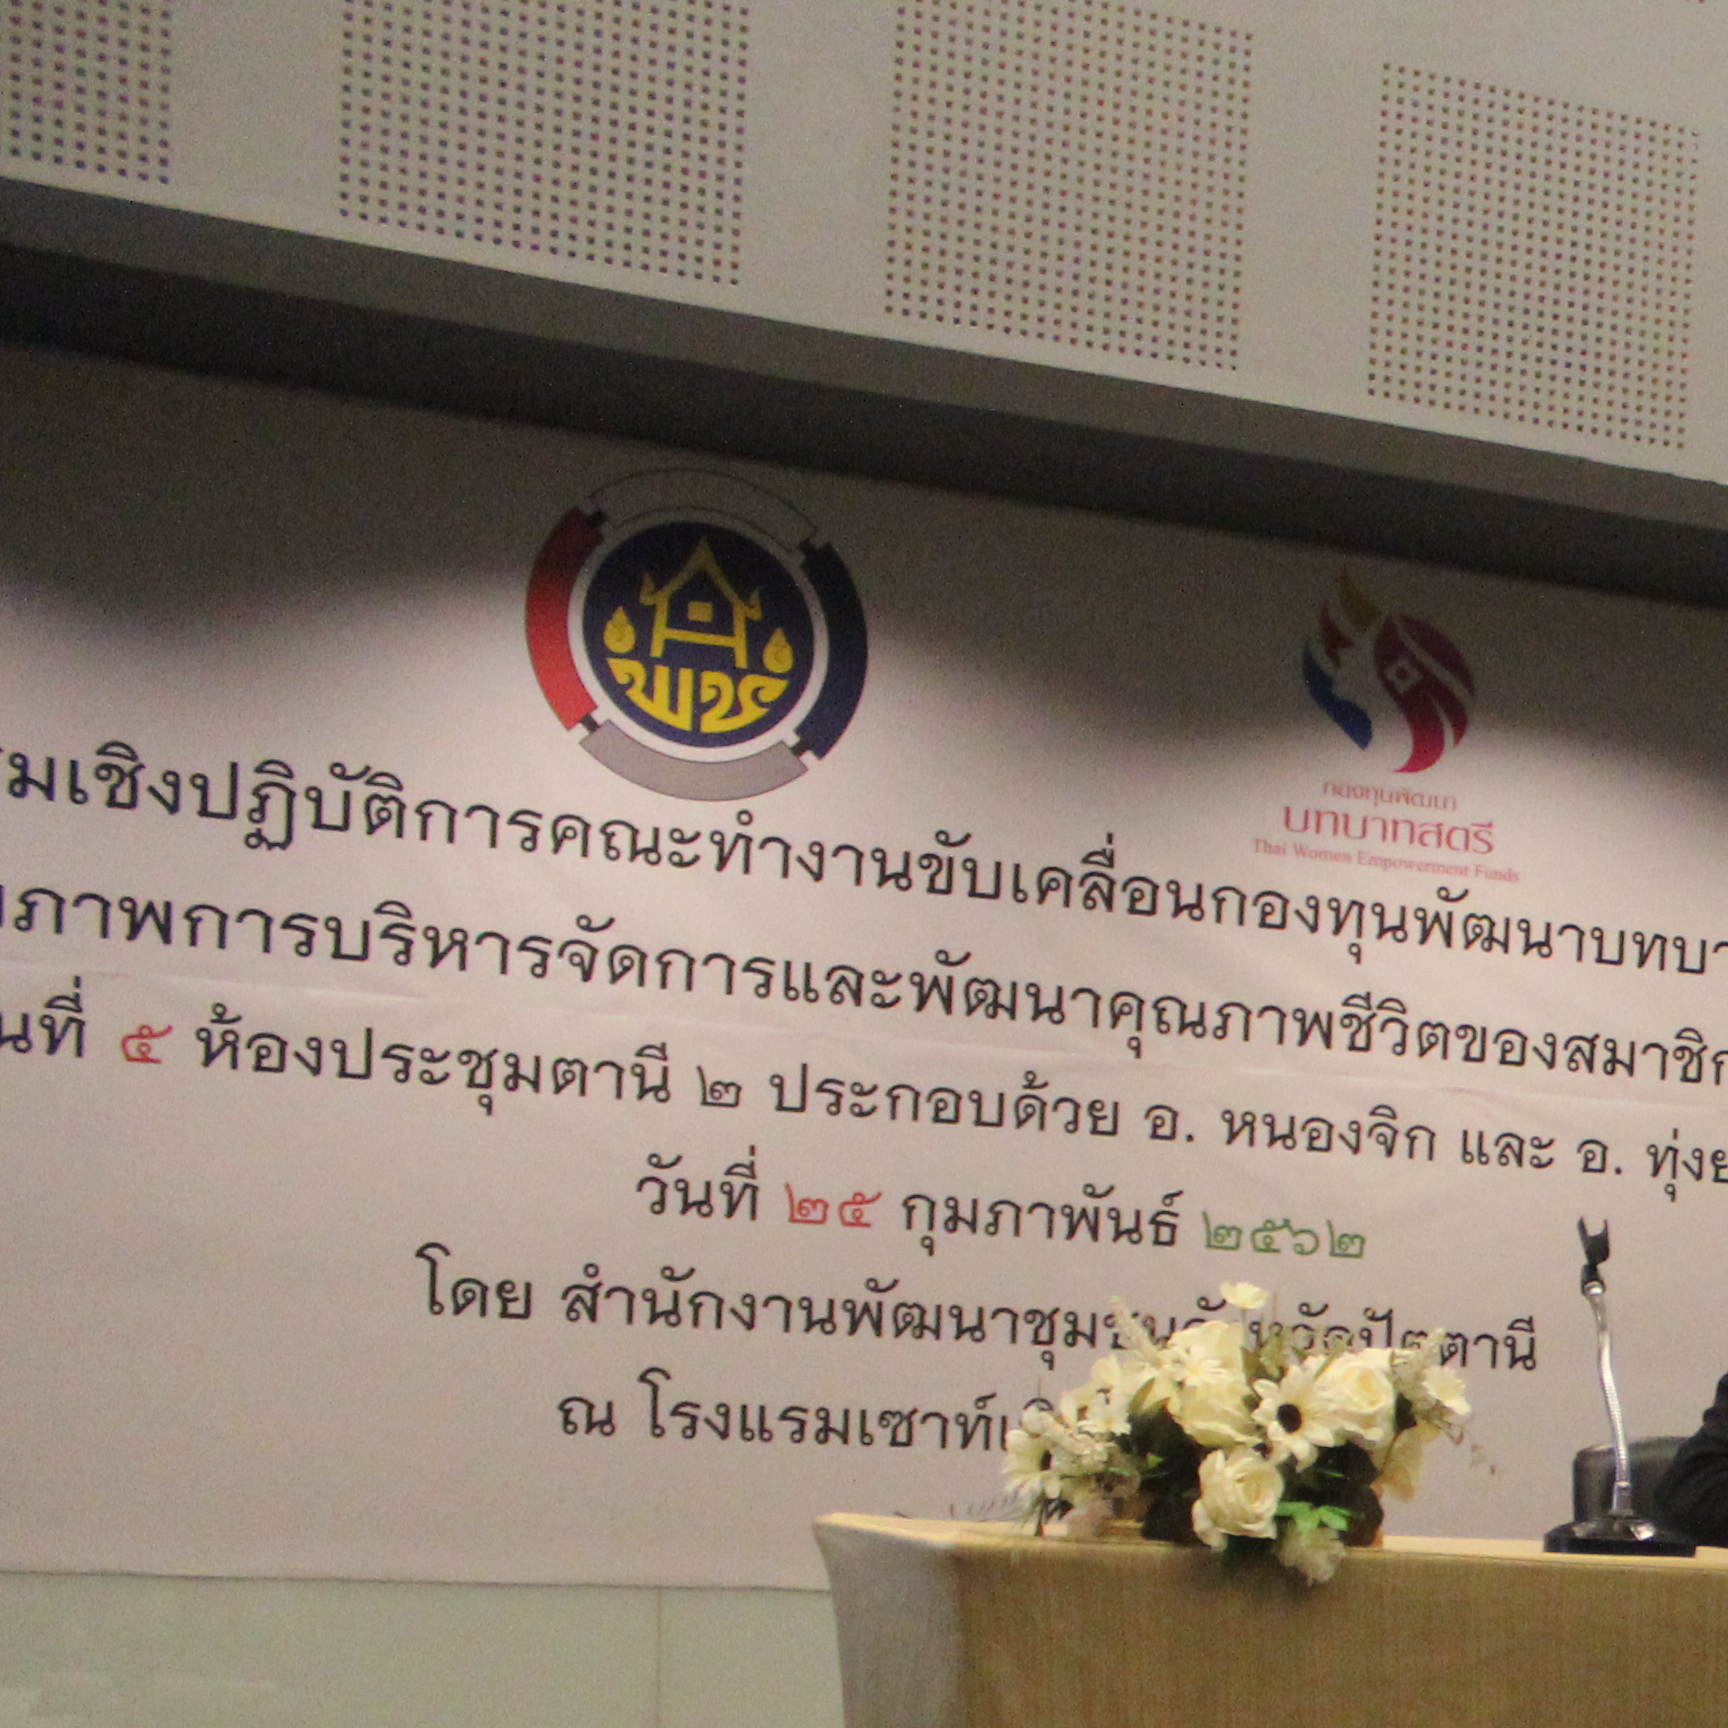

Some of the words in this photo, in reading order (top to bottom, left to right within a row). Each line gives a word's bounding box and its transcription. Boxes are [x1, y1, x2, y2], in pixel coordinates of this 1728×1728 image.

[1323, 780, 1457, 811] กองทุนพัฒนา
[1283, 805, 1495, 855] บทบาทสตรี
[1251, 838, 1287, 858] Thai
[1293, 844, 1352, 864] Women
[1356, 851, 1469, 879] Empowerment
[1474, 864, 1520, 883] Funds
[121, 1024, 173, 1064] ๕
[195, 1002, 670, 1116] ห้องประชุมตานี
[696, 1065, 743, 1110] ๒
[770, 1063, 1120, 1138] ประกอบด้วย
[1143, 1100, 1194, 1145] อ.
[1220, 1103, 1437, 1164] หนองจิก
[1459, 1130, 1554, 1171] และ
[1575, 1135, 1622, 1178] อ.
[637, 1145, 760, 1221] วันที่
[785, 1182, 883, 1229] ๒๕
[902, 1183, 1184, 1256] กุมภาพันธ์
[1202, 1210, 1366, 1259] ๒๕๖๒
[415, 1242, 533, 1322] โดย
[558, 1393, 616, 1438] ณ
